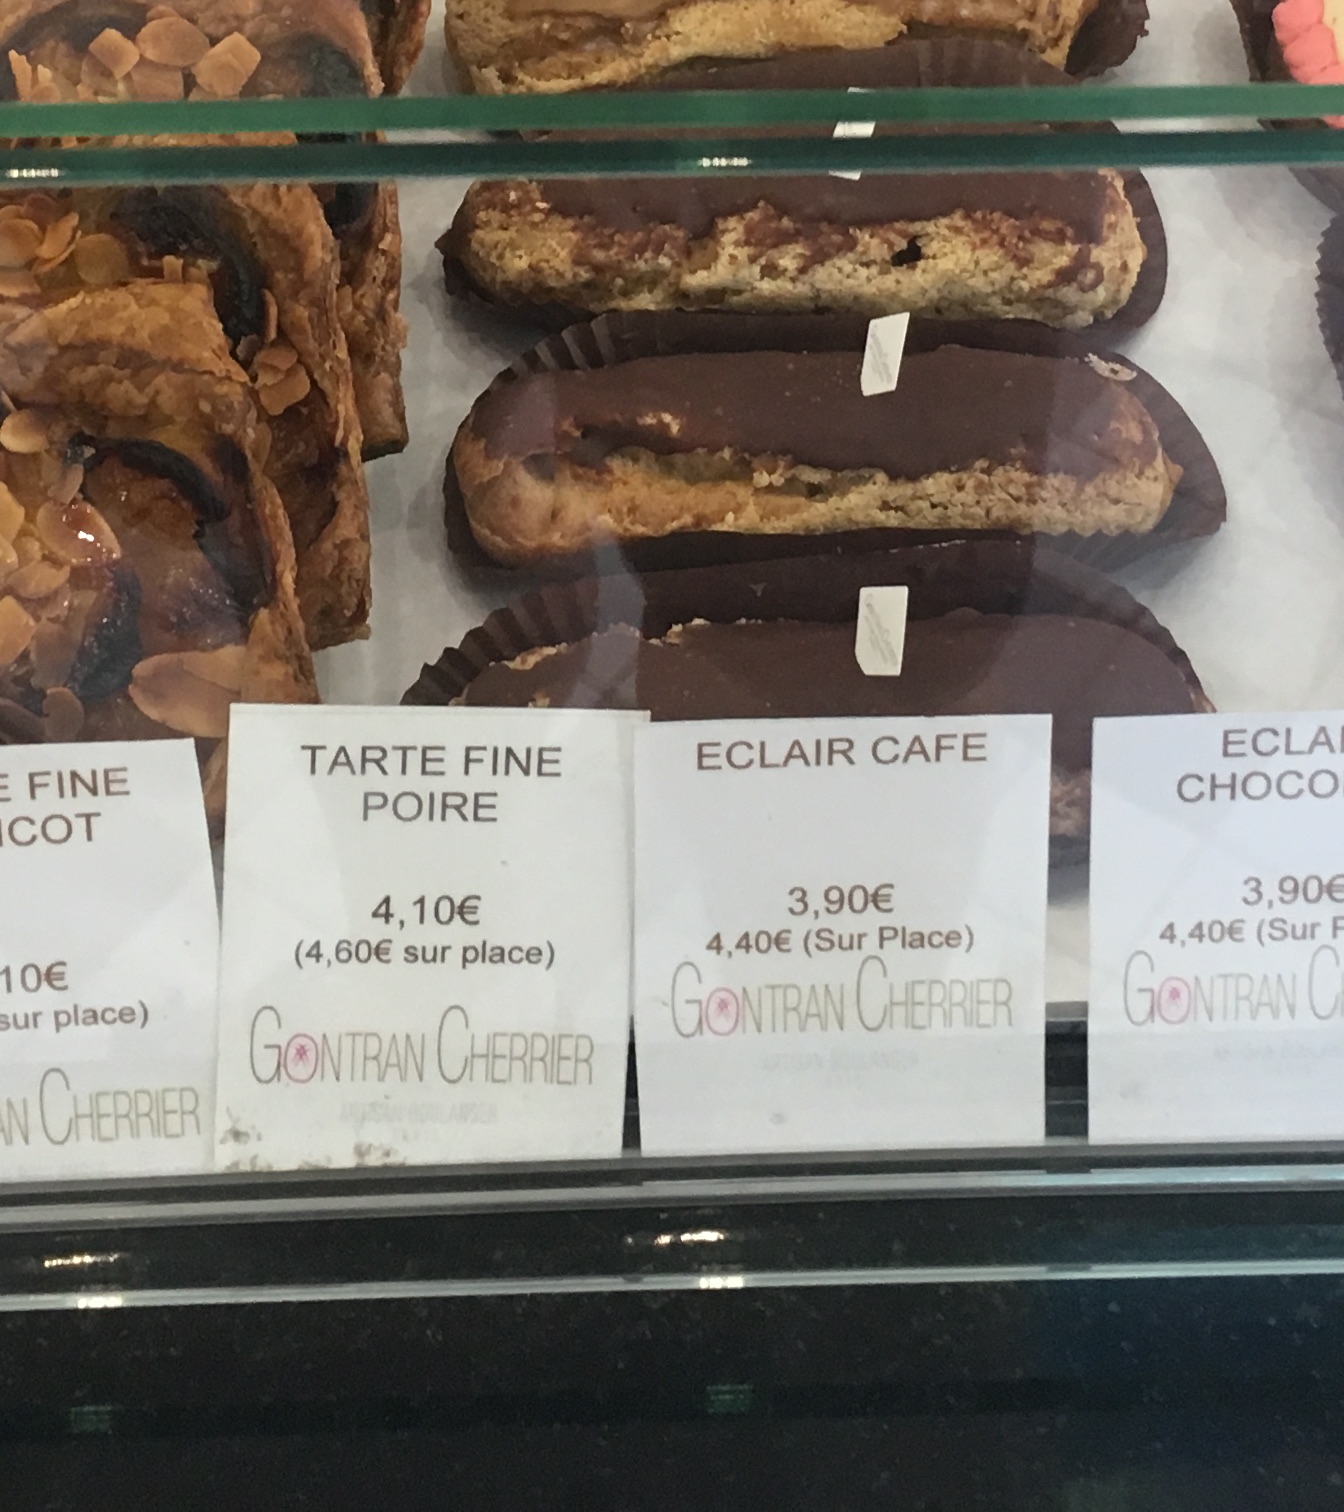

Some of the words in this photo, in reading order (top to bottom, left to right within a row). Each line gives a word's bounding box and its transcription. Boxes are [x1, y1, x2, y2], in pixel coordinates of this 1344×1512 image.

[301, 745, 445, 776] TARTE
[464, 746, 561, 777] FINE
[697, 738, 855, 770] ECLAIR
[871, 733, 986, 765] CAFE
[28, 767, 129, 800] FINE
[363, 792, 498, 822] POIRE
[372, 895, 481, 930] 4,10€
[788, 884, 894, 920] 3,90€
[706, 929, 791, 958] 4,40€
[803, 928, 867, 958] (Sur
[878, 926, 973, 951] Place)
[1159, 918, 1245, 946] 4,40€
[1257, 917, 1321, 947] (Sur
[295, 938, 392, 969] (4,60€
[404, 945, 451, 964] sur
[462, 940, 555, 969] place)
[54, 1001, 149, 1034] place)
